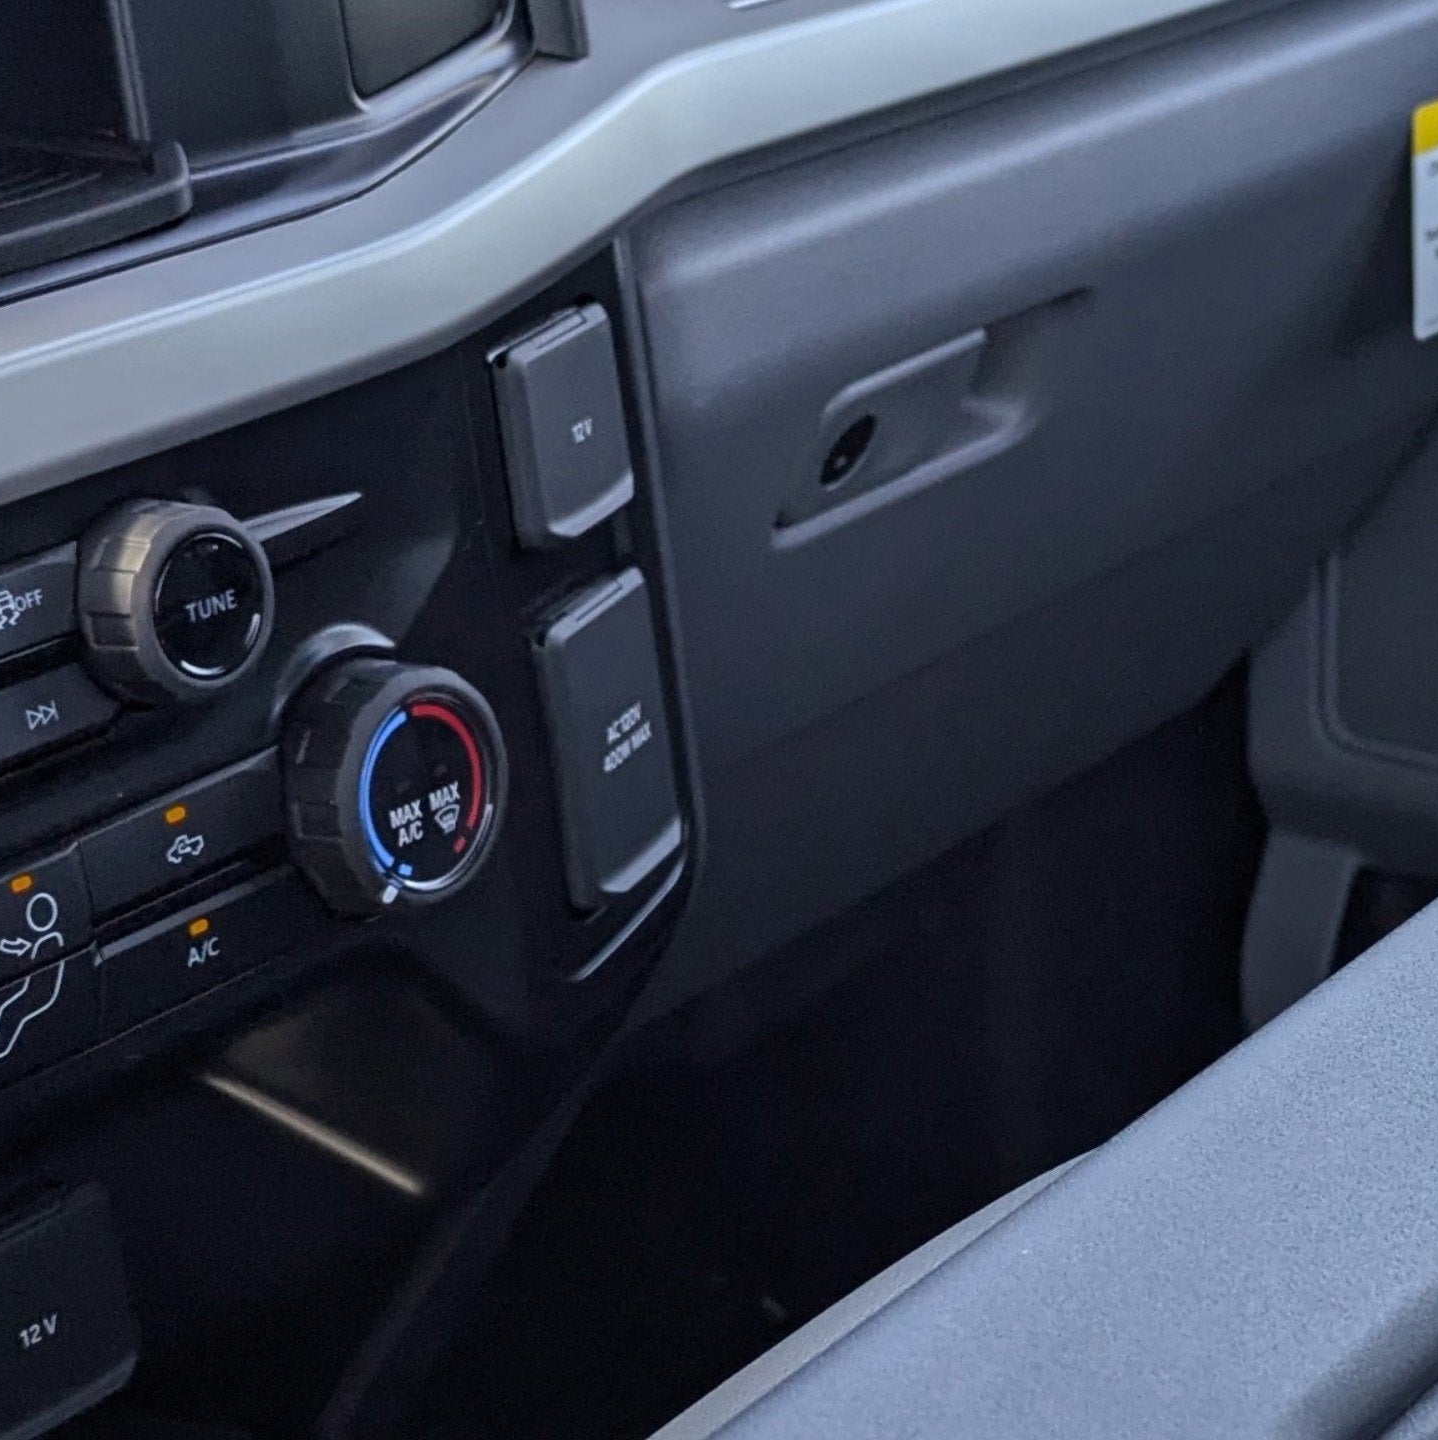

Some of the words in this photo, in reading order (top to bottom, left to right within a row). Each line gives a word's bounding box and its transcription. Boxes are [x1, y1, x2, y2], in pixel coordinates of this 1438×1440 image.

[13, 588, 44, 613] OFF
[184, 588, 239, 623] TUNE
[428, 781, 461, 811] MAX
[388, 799, 424, 830] MAX
[398, 820, 424, 848] A/C
[186, 935, 221, 968] A/C
